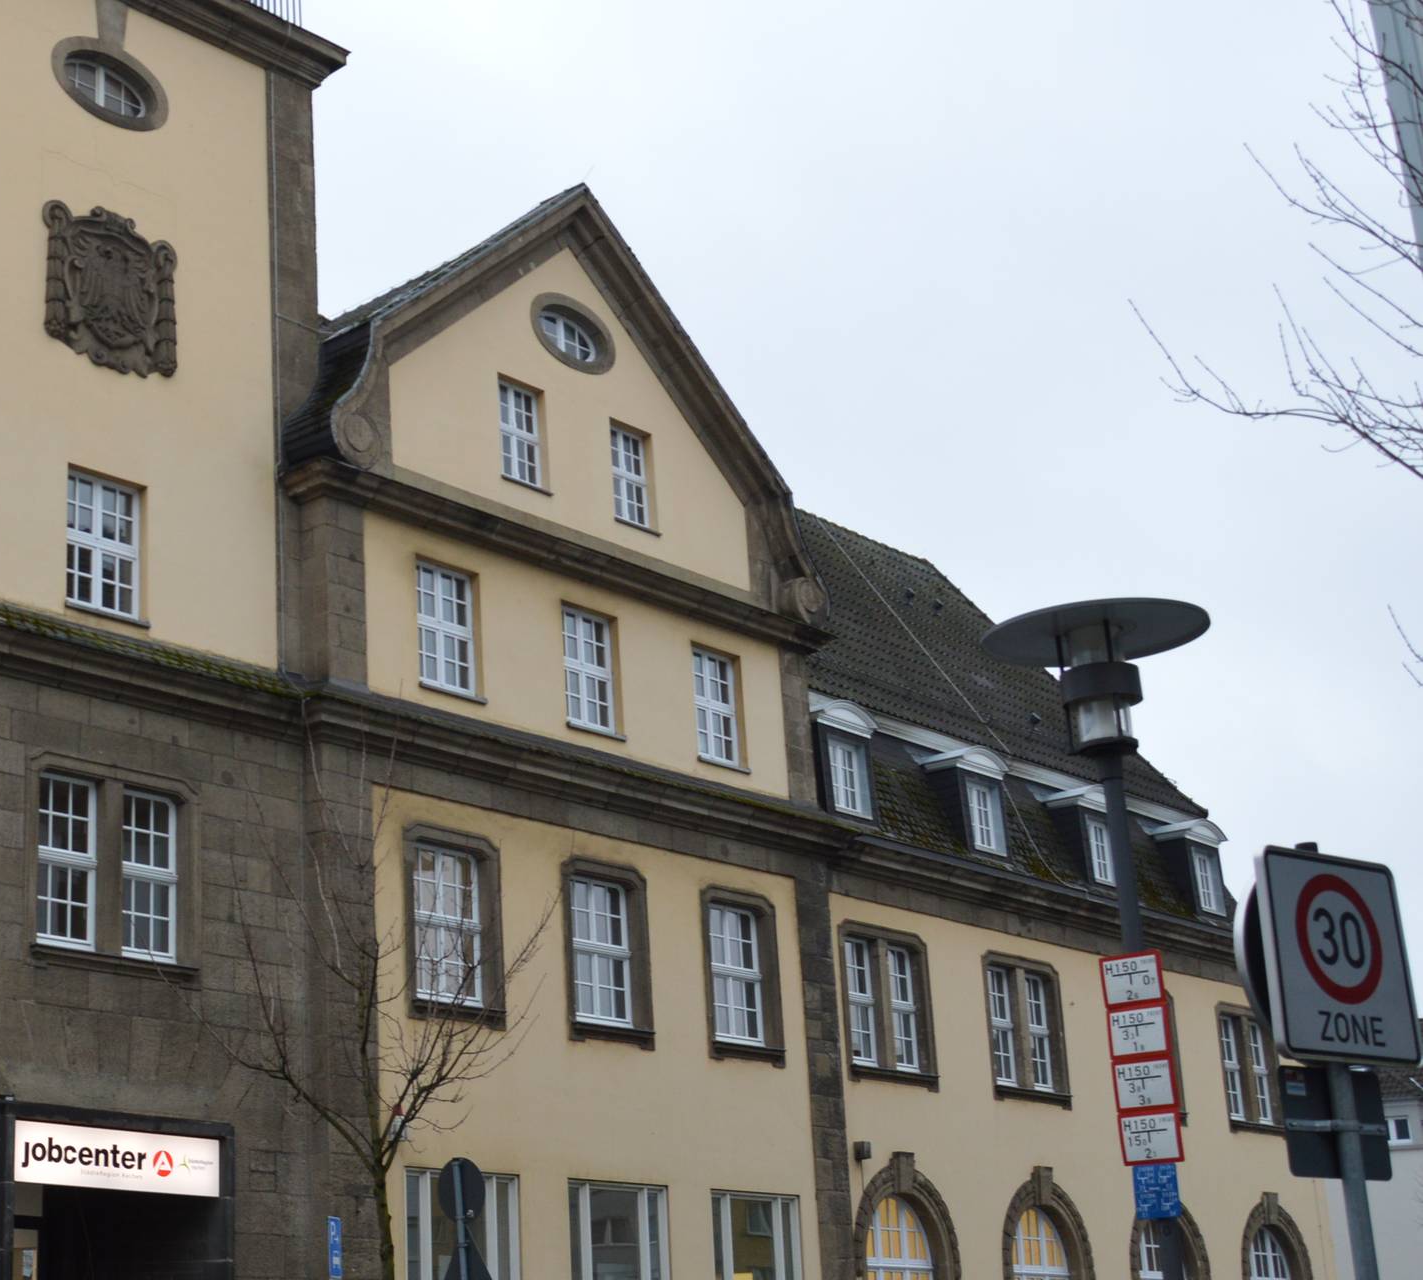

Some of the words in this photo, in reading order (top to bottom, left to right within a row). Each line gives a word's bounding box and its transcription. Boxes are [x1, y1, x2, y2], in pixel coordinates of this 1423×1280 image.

[1313, 907, 1365, 969] 30
[1105, 961, 1137, 975] H150
[1112, 1013, 1144, 1027] H150
[1318, 1010, 1386, 1047] ZONE
[1118, 1065, 1150, 1078] H150
[1123, 1119, 1156, 1131] H150
[22, 1137, 146, 1170] jobcenter
